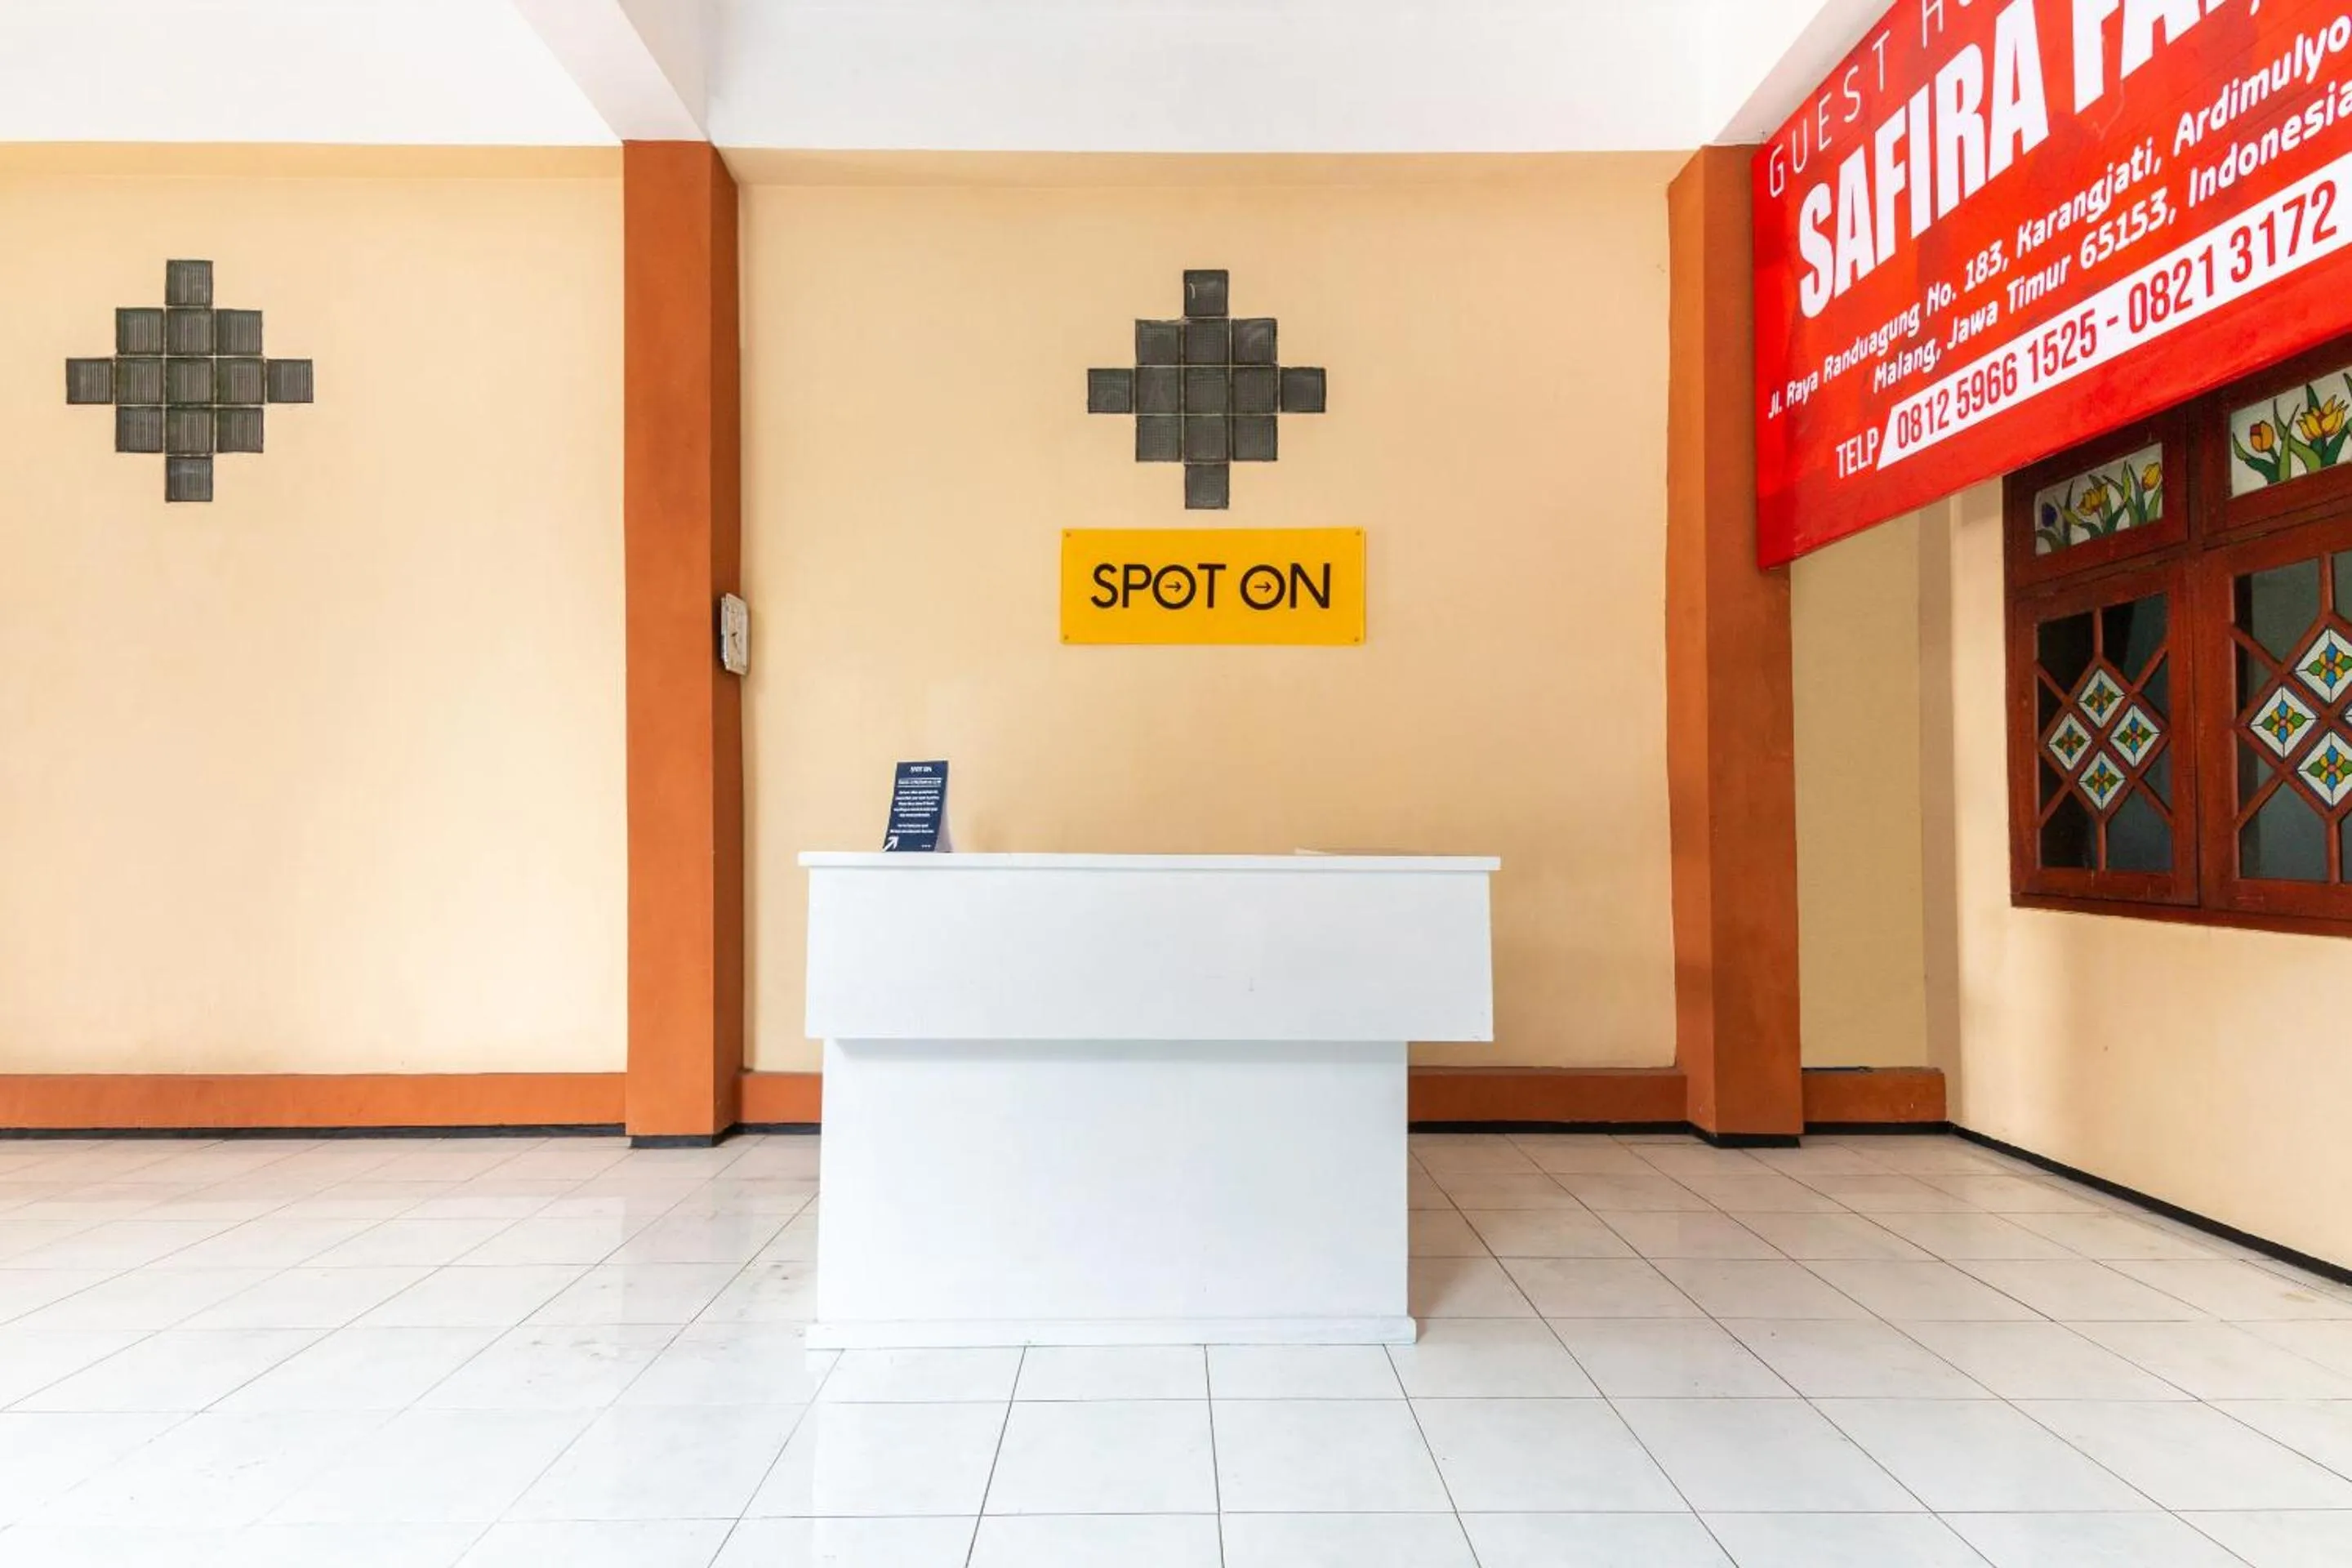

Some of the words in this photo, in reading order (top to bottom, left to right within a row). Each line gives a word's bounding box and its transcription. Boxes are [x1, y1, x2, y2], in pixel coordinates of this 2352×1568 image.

[1769, 30, 1891, 198] GUEST
[1787, 370, 1819, 408] Raya
[1824, 302, 1920, 383] Randuagung
[1927, 282, 1957, 316] No.
[1964, 239, 2008, 292] 183,
[2016, 136, 2162, 258] Karangjati,
[2173, 15, 2352, 157] Ardimulyo
[1799, 0, 2049, 318] SAFIRA
[1873, 337, 1941, 394] Malang,
[1947, 301, 1998, 350] Jawa
[2007, 255, 2071, 314] Timur
[2080, 187, 2176, 270] 65153,
[2188, 80, 2352, 207] Indonesia
[1836, 426, 1879, 479] TELP
[1896, 388, 1949, 449] 0812
[1957, 352, 2017, 419] 5966
[2028, 308, 2097, 384] 1525
[2128, 243, 2215, 335] 0821
[2230, 180, 2337, 283] 3172
[1090, 563, 1227, 610] SPOT
[1240, 563, 1330, 610] ON
